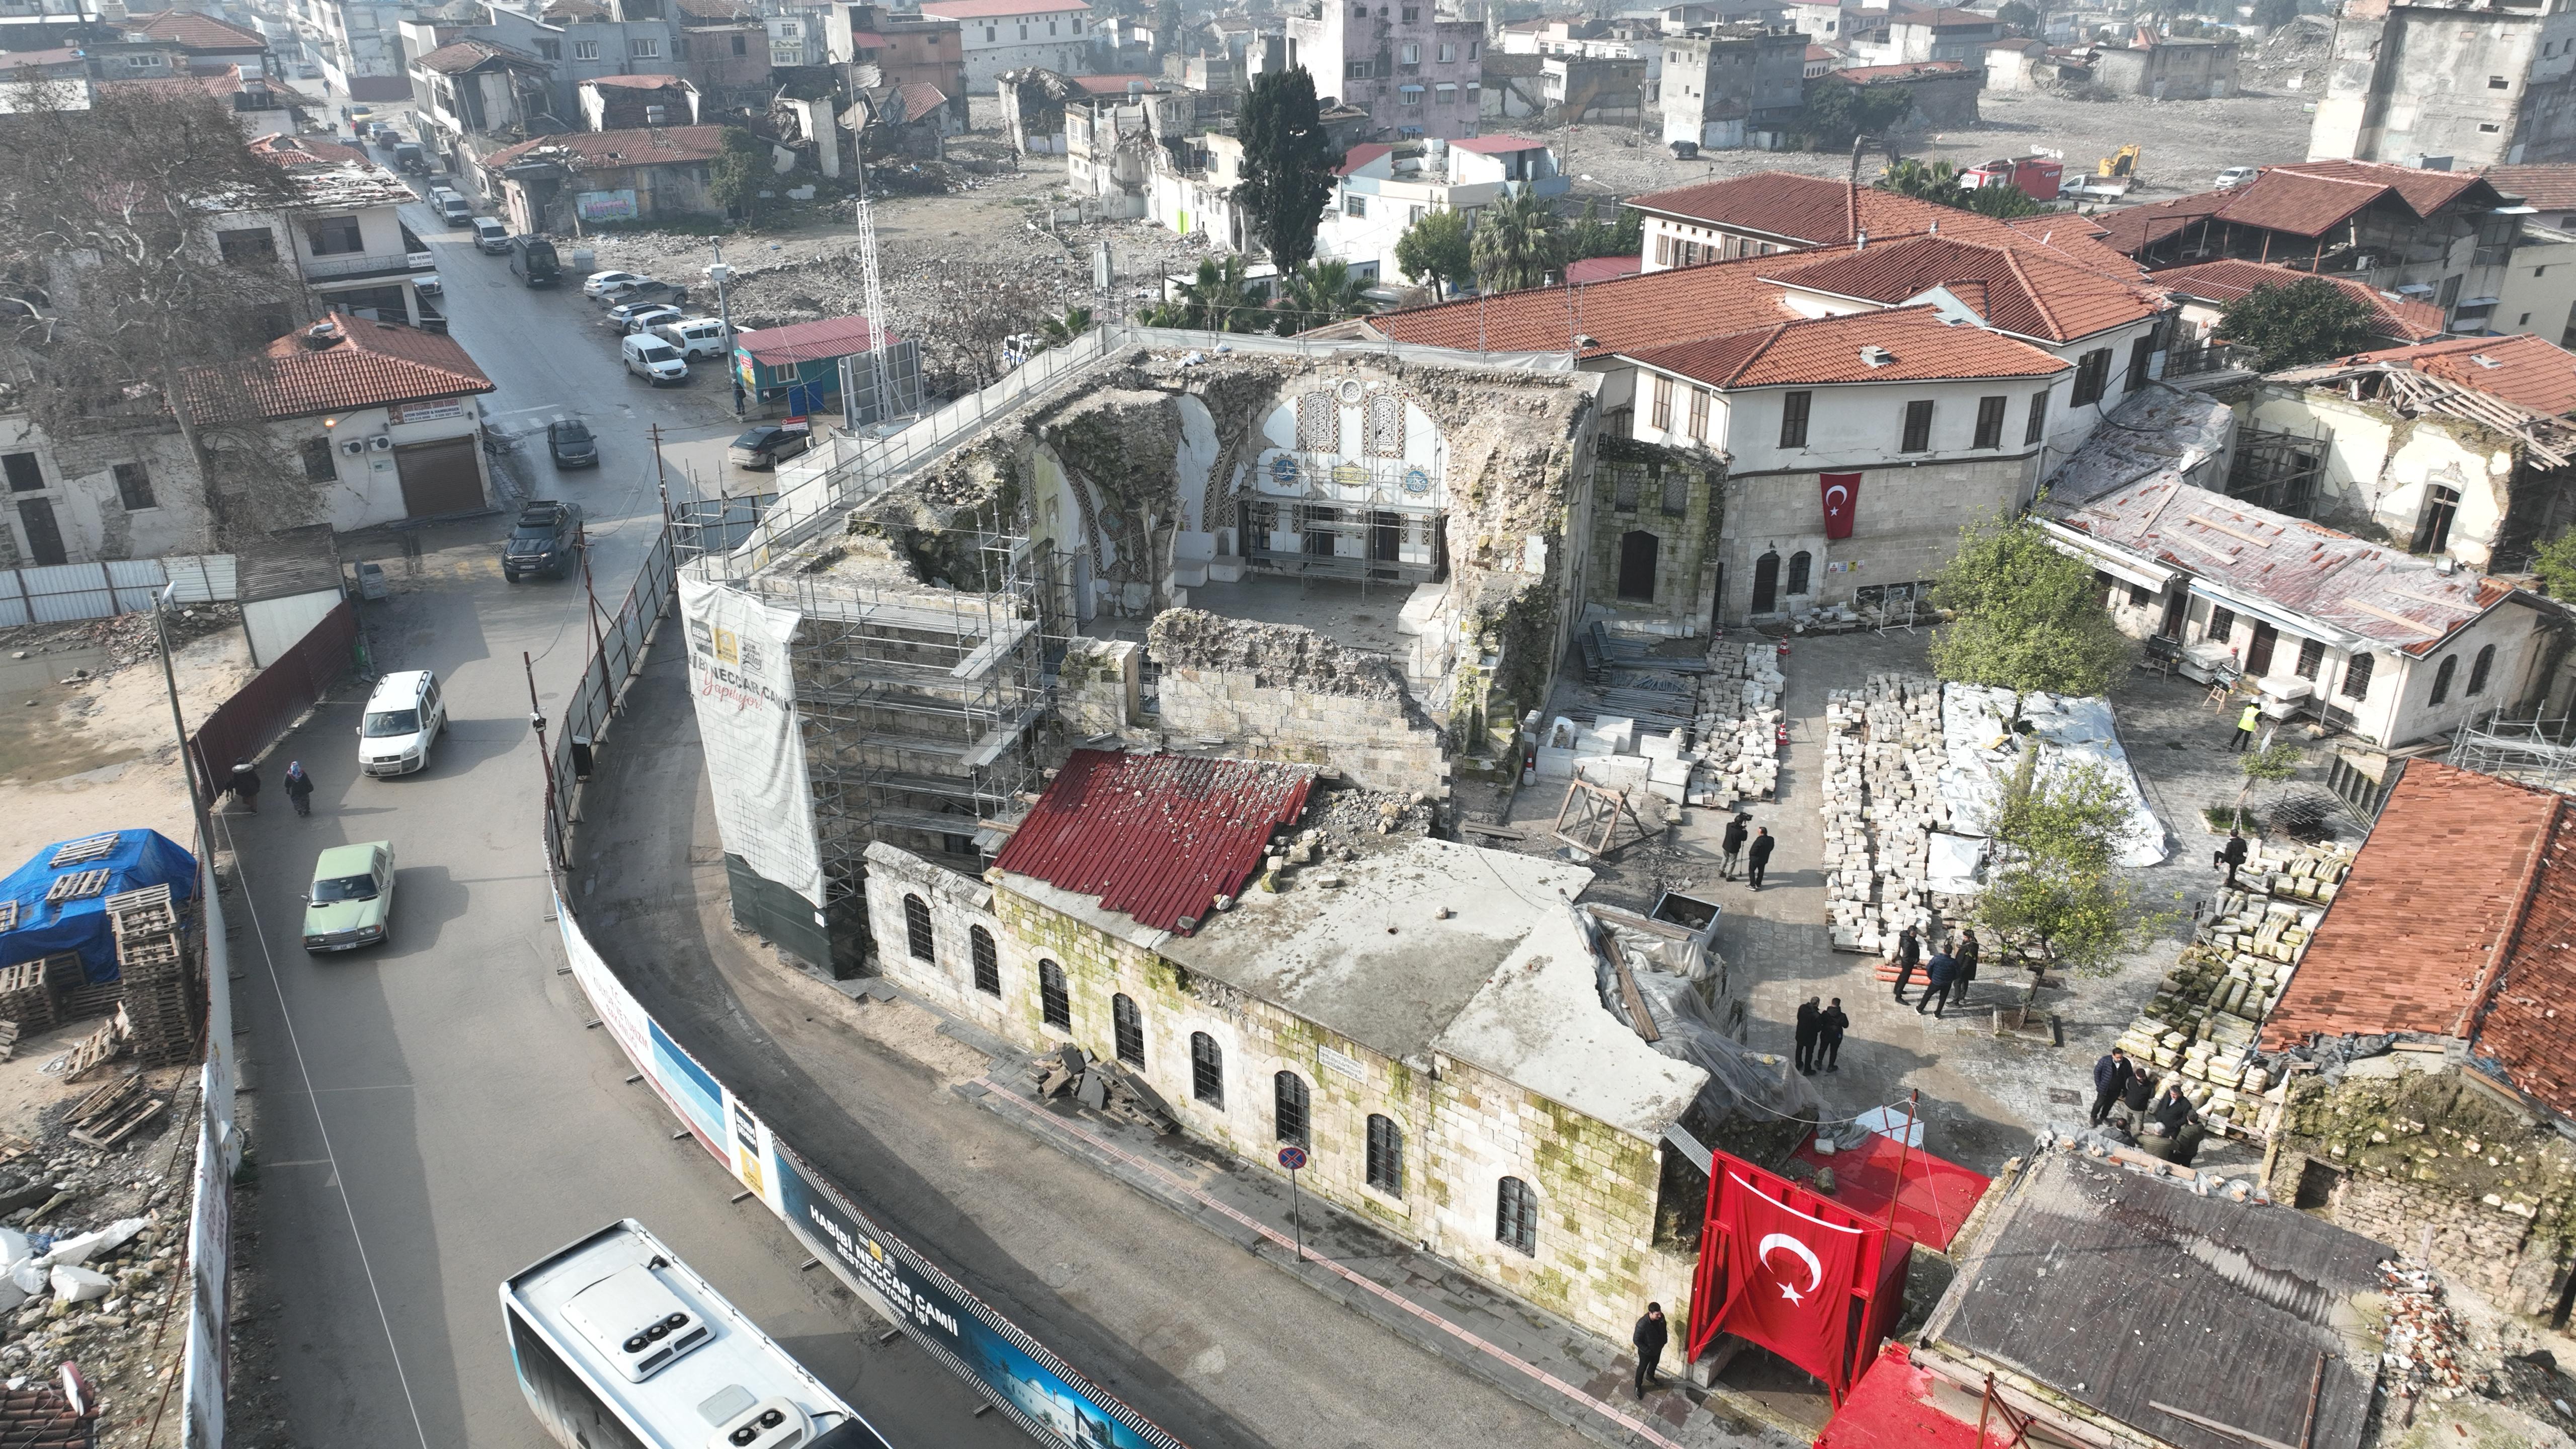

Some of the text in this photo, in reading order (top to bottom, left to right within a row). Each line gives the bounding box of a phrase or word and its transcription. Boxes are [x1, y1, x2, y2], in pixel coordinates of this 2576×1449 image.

[711, 667, 761, 696] NECCAR
[623, 1014, 649, 1051] TURİZM
[810, 1204, 958, 1337] HABİBİ NECCAR CAMİİ
[836, 1242, 913, 1313] RESTORASYONU
[870, 1285, 906, 1319] RESTORASYON
